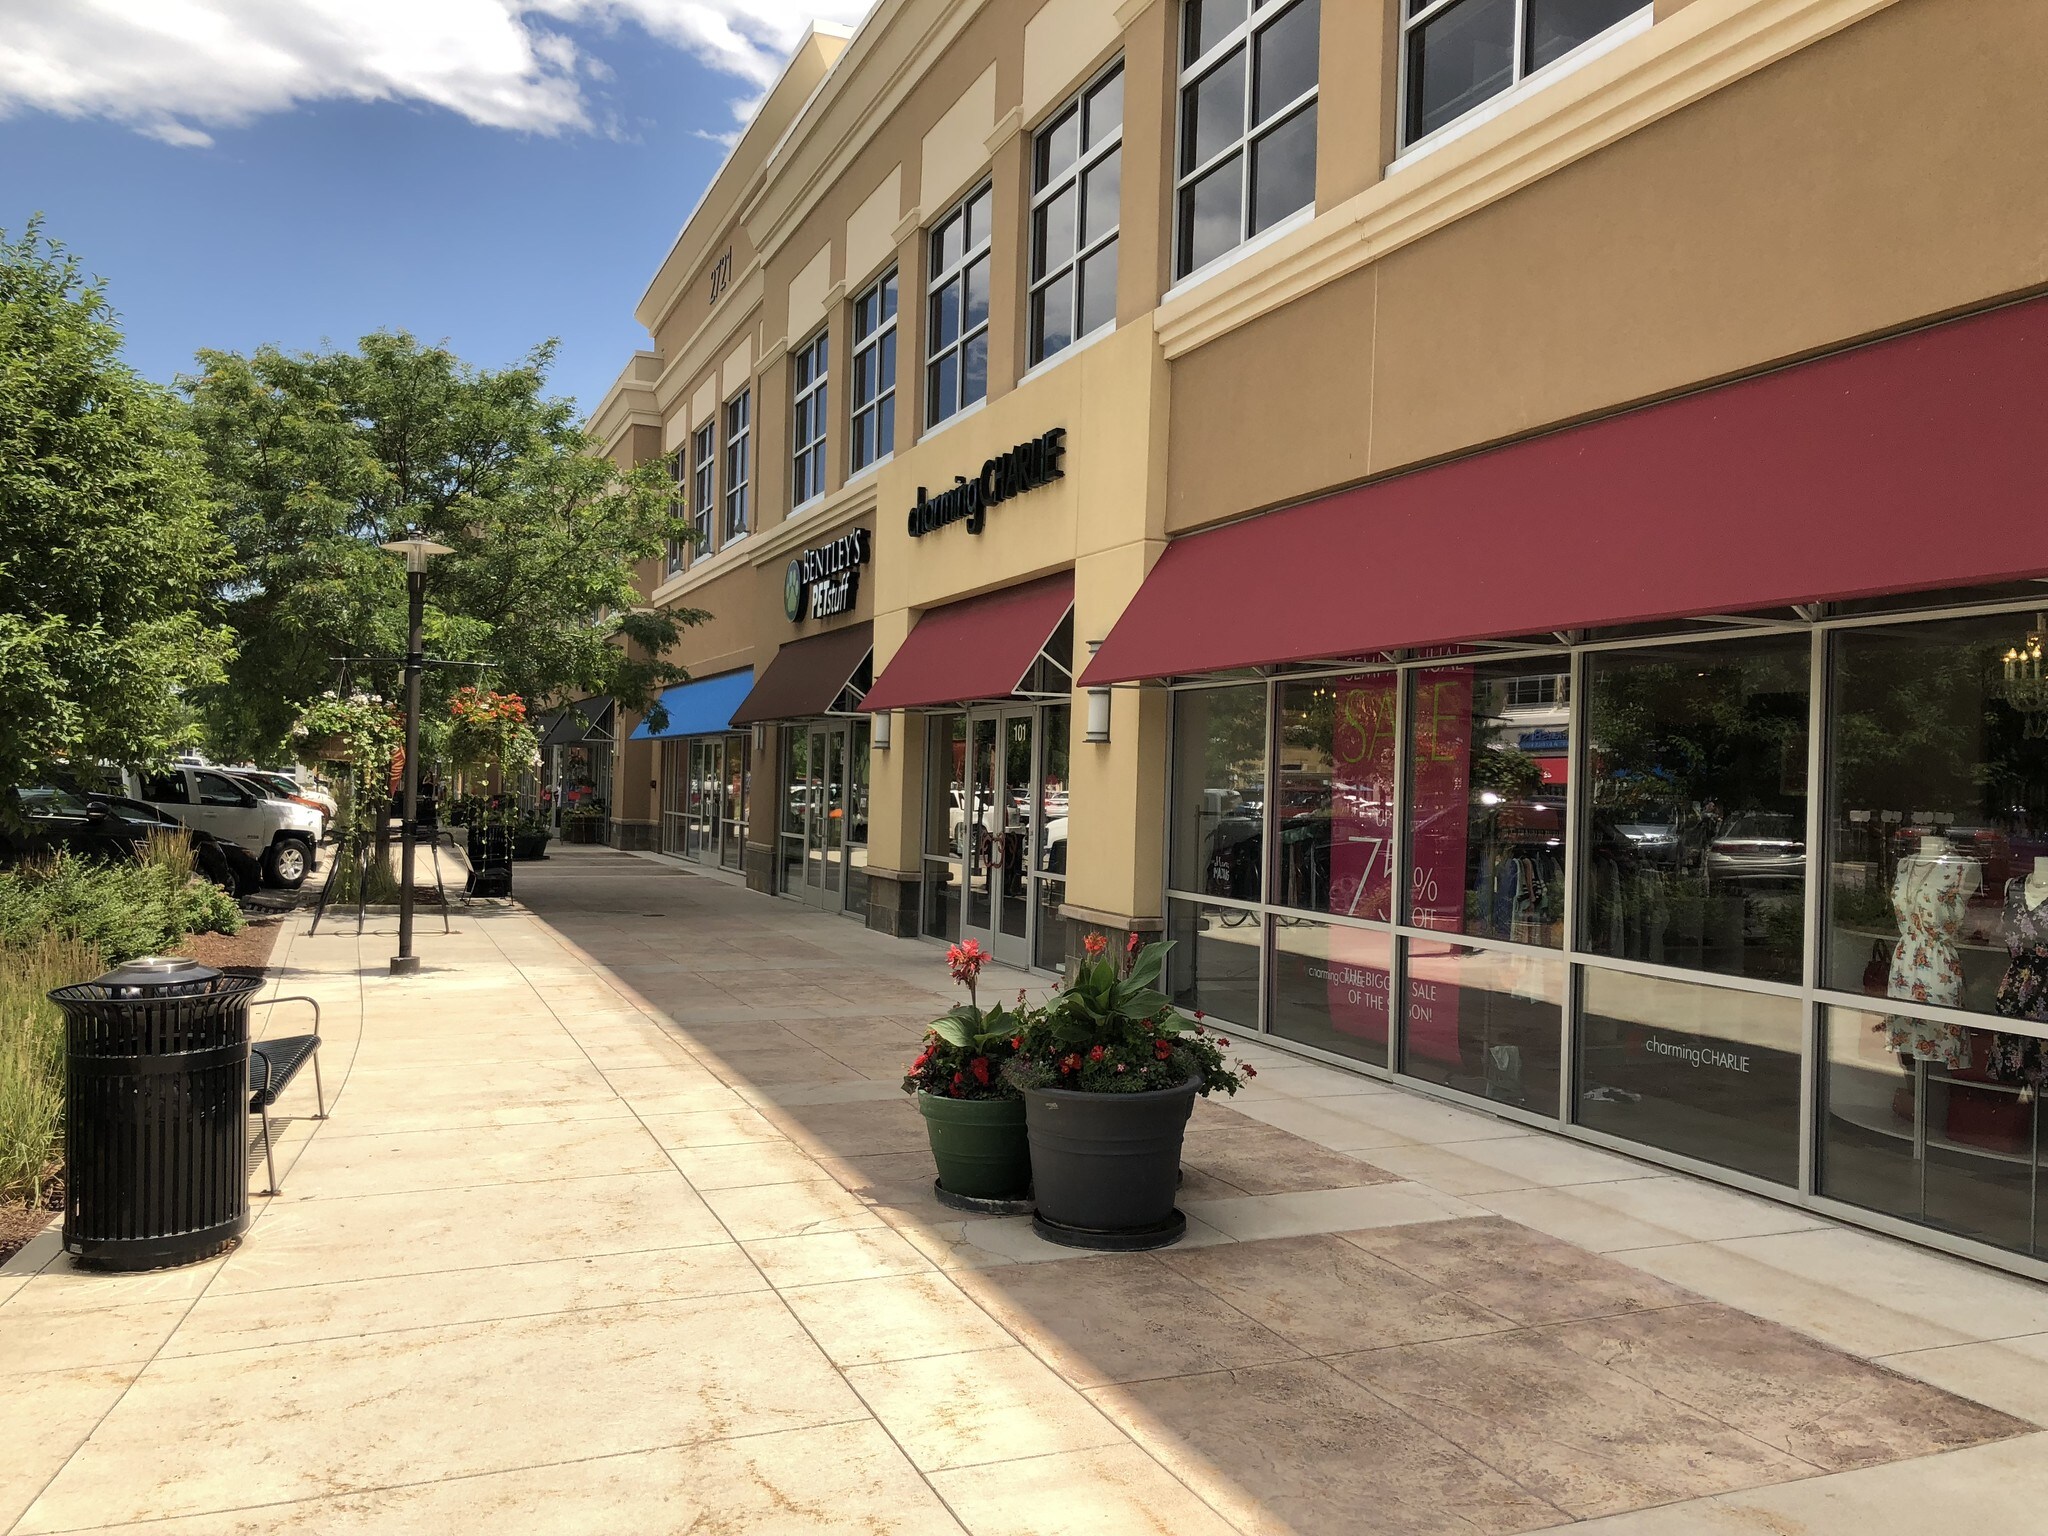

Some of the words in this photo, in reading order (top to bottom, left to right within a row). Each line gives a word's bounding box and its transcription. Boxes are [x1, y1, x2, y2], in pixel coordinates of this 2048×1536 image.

[709, 245, 732, 305] 2721
[803, 527, 861, 584] BENTLEY'S
[1014, 724, 1026, 741] 101
[1342, 682, 1458, 764] SAE
[1412, 907, 1436, 929] OFF
[1348, 989, 1361, 1005] OF
[1365, 993, 1383, 1011] THE
[1412, 982, 1437, 1001] SALE
